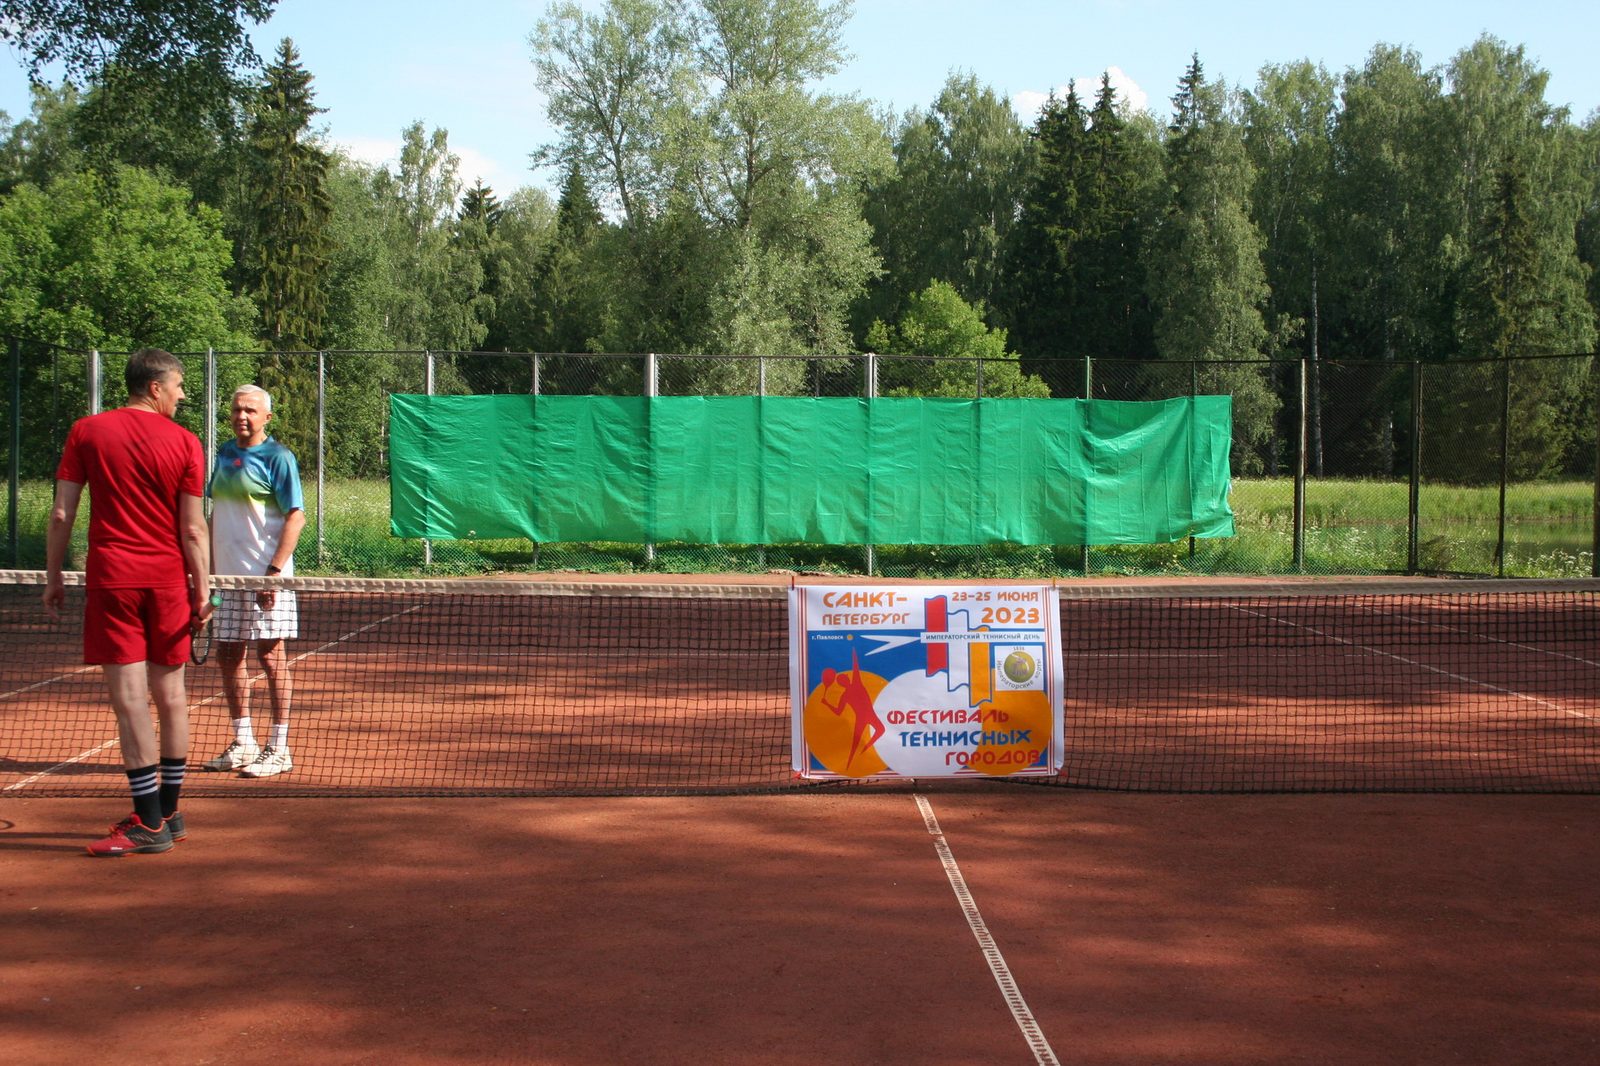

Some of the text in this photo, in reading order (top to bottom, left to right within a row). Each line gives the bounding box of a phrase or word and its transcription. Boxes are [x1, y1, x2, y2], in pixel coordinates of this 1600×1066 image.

[822, 592, 908, 608] САНКТ-
[952, 592, 1039, 602] 23-25 ИЮНЯ
[822, 613, 910, 625] ПЕТЕРБУРГ
[981, 607, 1040, 624] 2023
[1023, 633, 1040, 641] ДЕНЬ
[886, 709, 1009, 725] ФЕСТИВАЛЬ
[898, 729, 1032, 747] ТЕННИСНЫХ
[945, 750, 1041, 766] ГОРОДОВ
